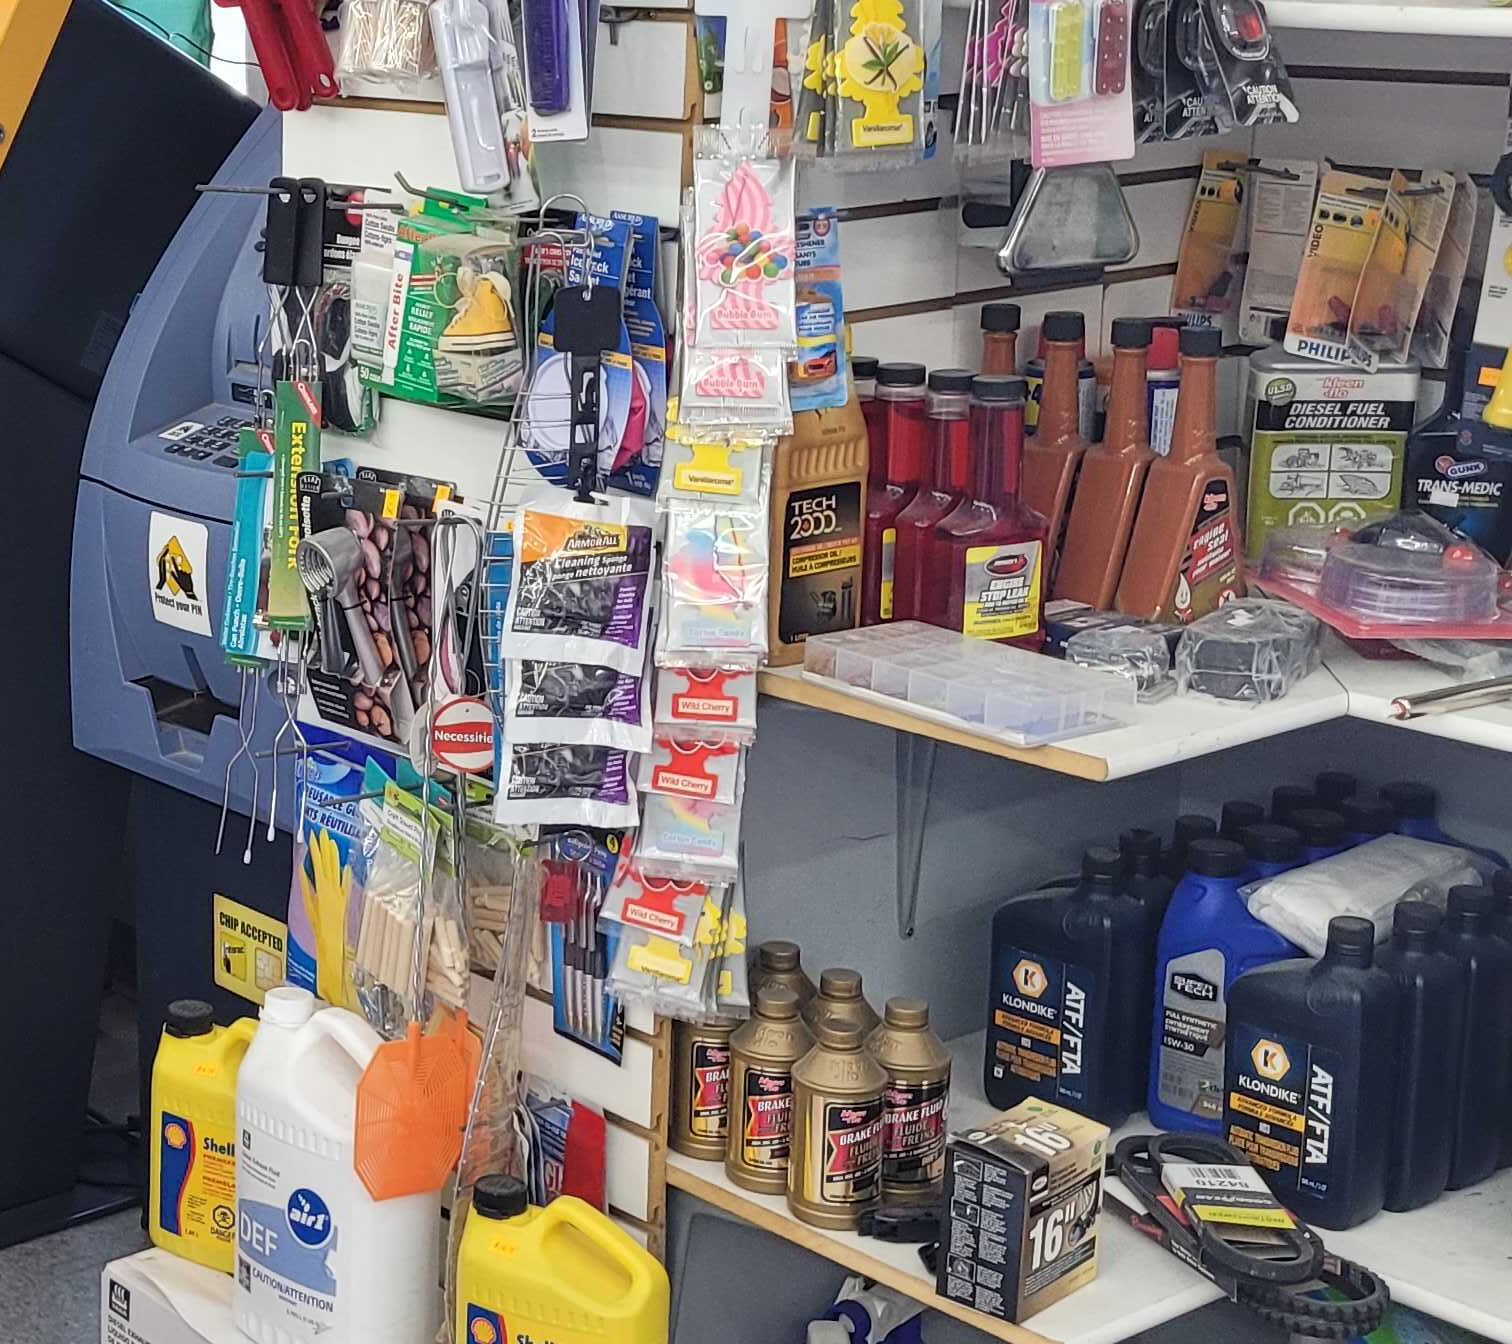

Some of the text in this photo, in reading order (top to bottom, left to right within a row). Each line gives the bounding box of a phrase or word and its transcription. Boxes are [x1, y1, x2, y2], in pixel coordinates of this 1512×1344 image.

[388, 273, 405, 350] After Bite
[410, 304, 434, 318] RELIEF
[716, 310, 748, 323] Bubble
[410, 323, 432, 335] RAPIDE
[703, 377, 734, 391] Bubble
[1288, 400, 1386, 417] DIESEL FUEL
[1284, 415, 1390, 430] CONDITIONER
[1448, 462, 1482, 477] GUNK
[1417, 479, 1502, 497] TRANS-MEDIC
[791, 495, 836, 511] TECH
[790, 511, 835, 540] 2000
[567, 536, 619, 549] ARMORALL
[556, 555, 628, 569] Cleaning Sponge
[576, 564, 632, 577] nettoyante
[980, 586, 1029, 602] STOP LEAK
[154, 592, 202, 616] Protect your PIN
[680, 701, 732, 715] Wild Cherry
[659, 774, 710, 794] Wild Cherry
[626, 906, 679, 929] Wild Cherry
[219, 911, 284, 953] CHIP ACCEPTED
[1002, 993, 1055, 1020] KLONDIKE
[1062, 981, 1086, 1074] ATF/FTA
[1238, 1075, 1299, 1105] KLONDIKE
[757, 1098, 790, 1112] BRAKE
[885, 1099, 943, 1124] BRAKE FLUID
[1305, 1063, 1334, 1164] ATF/FTA
[839, 1129, 872, 1145] BRAKE
[902, 1131, 934, 1147] FREINS
[1014, 1124, 1071, 1156] 16"
[289, 1204, 326, 1232] air1
[240, 1209, 277, 1257] DEF
[1030, 1201, 1076, 1272] 16"
